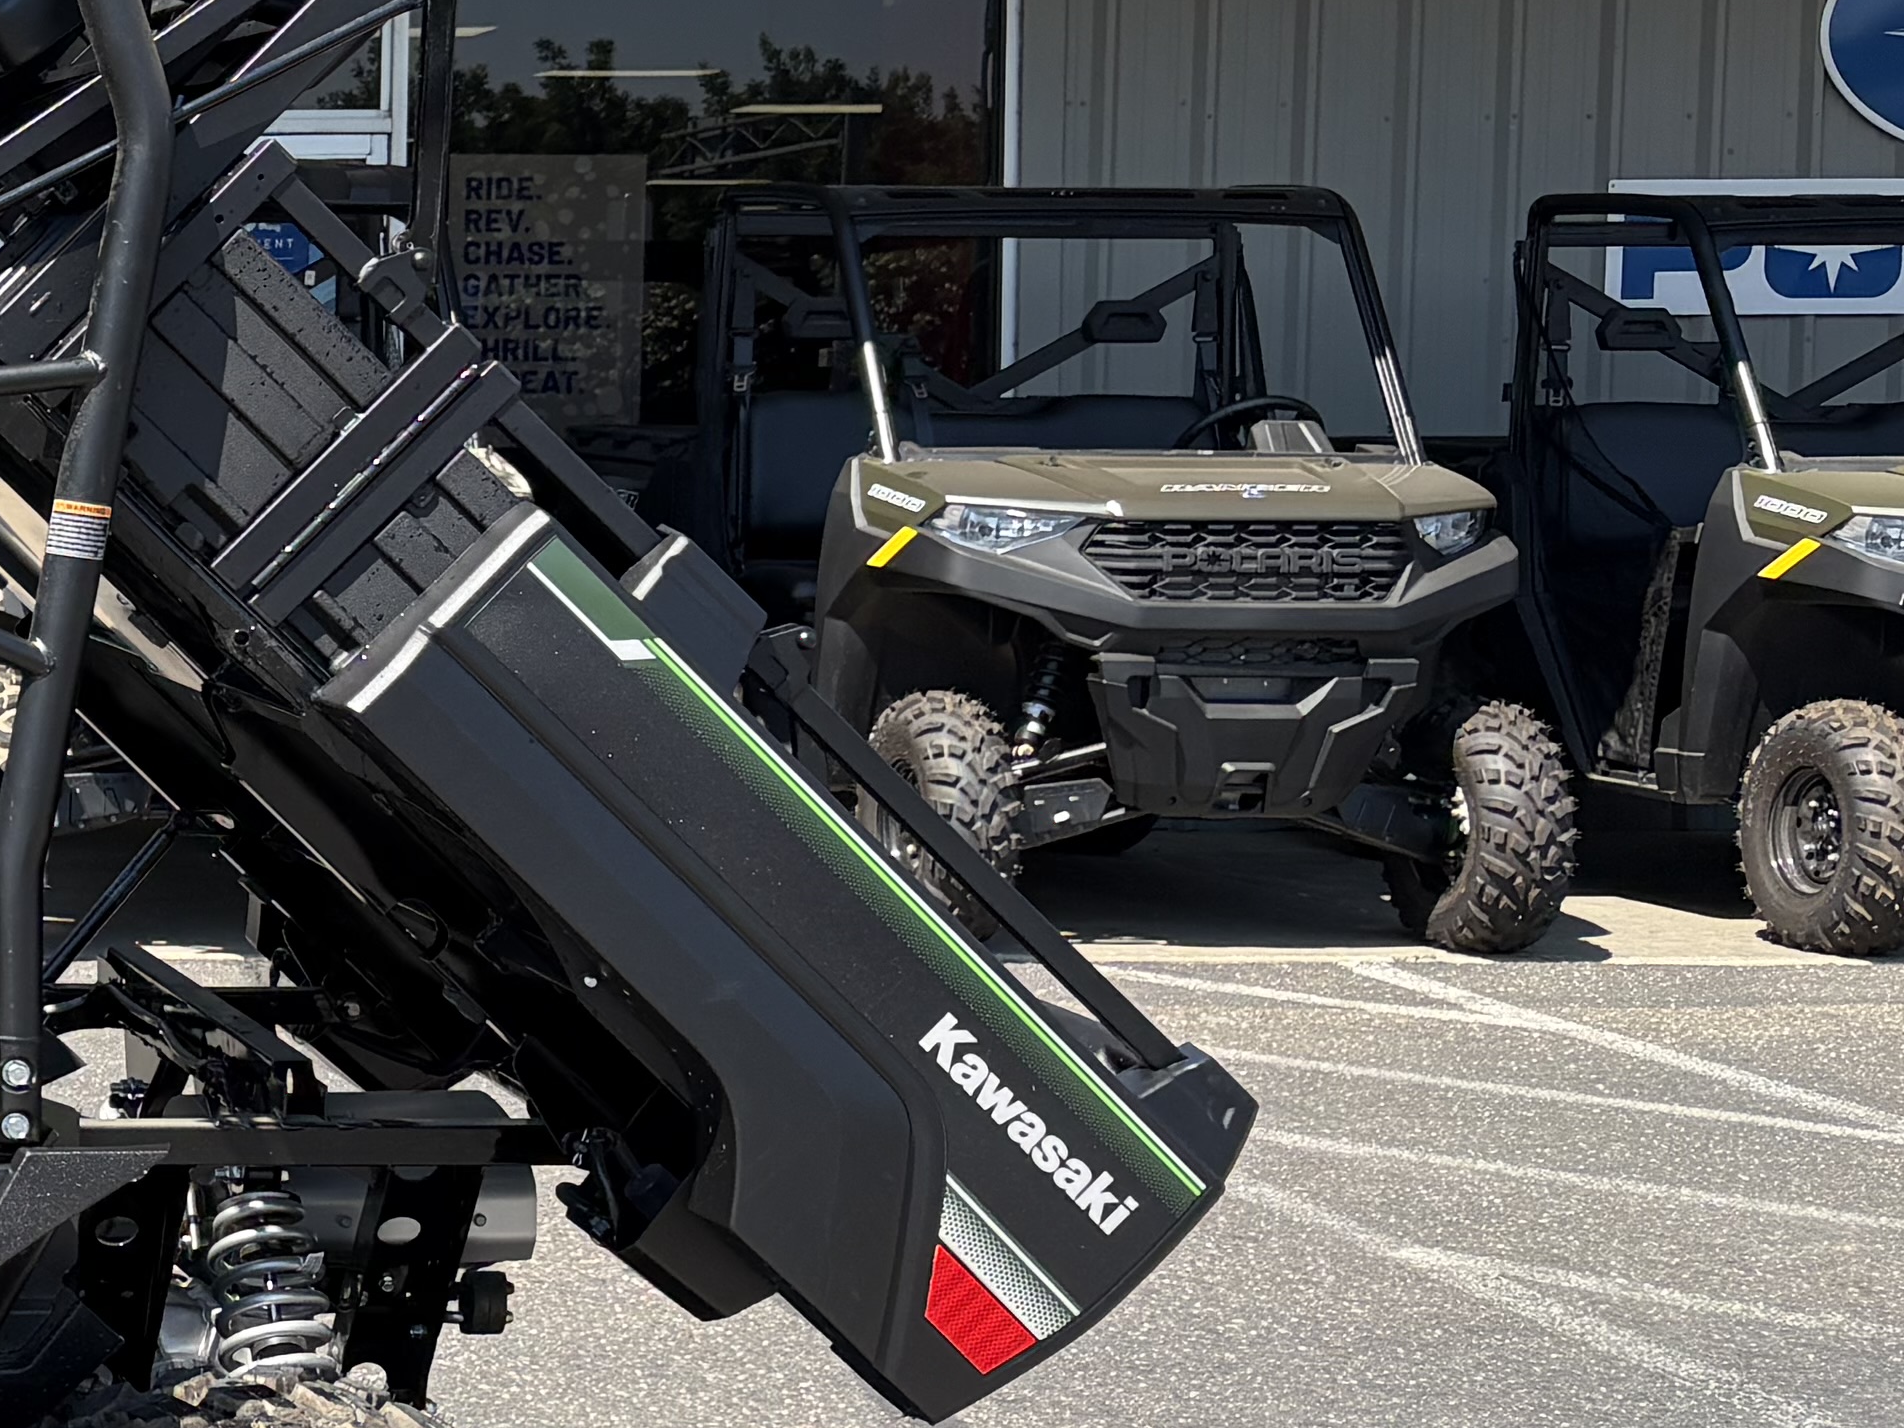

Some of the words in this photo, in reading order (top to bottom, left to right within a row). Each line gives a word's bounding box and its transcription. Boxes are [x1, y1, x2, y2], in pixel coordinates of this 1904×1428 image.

[464, 176, 543, 201] RIDE.
[464, 208, 531, 234] REV.
[462, 240, 574, 266] CHASE.
[480, 338, 578, 363] HRILL.
[1752, 494, 1829, 524] 1000
[1161, 546, 1363, 573] POLARIS
[917, 1011, 1140, 1236] Kawasaki
